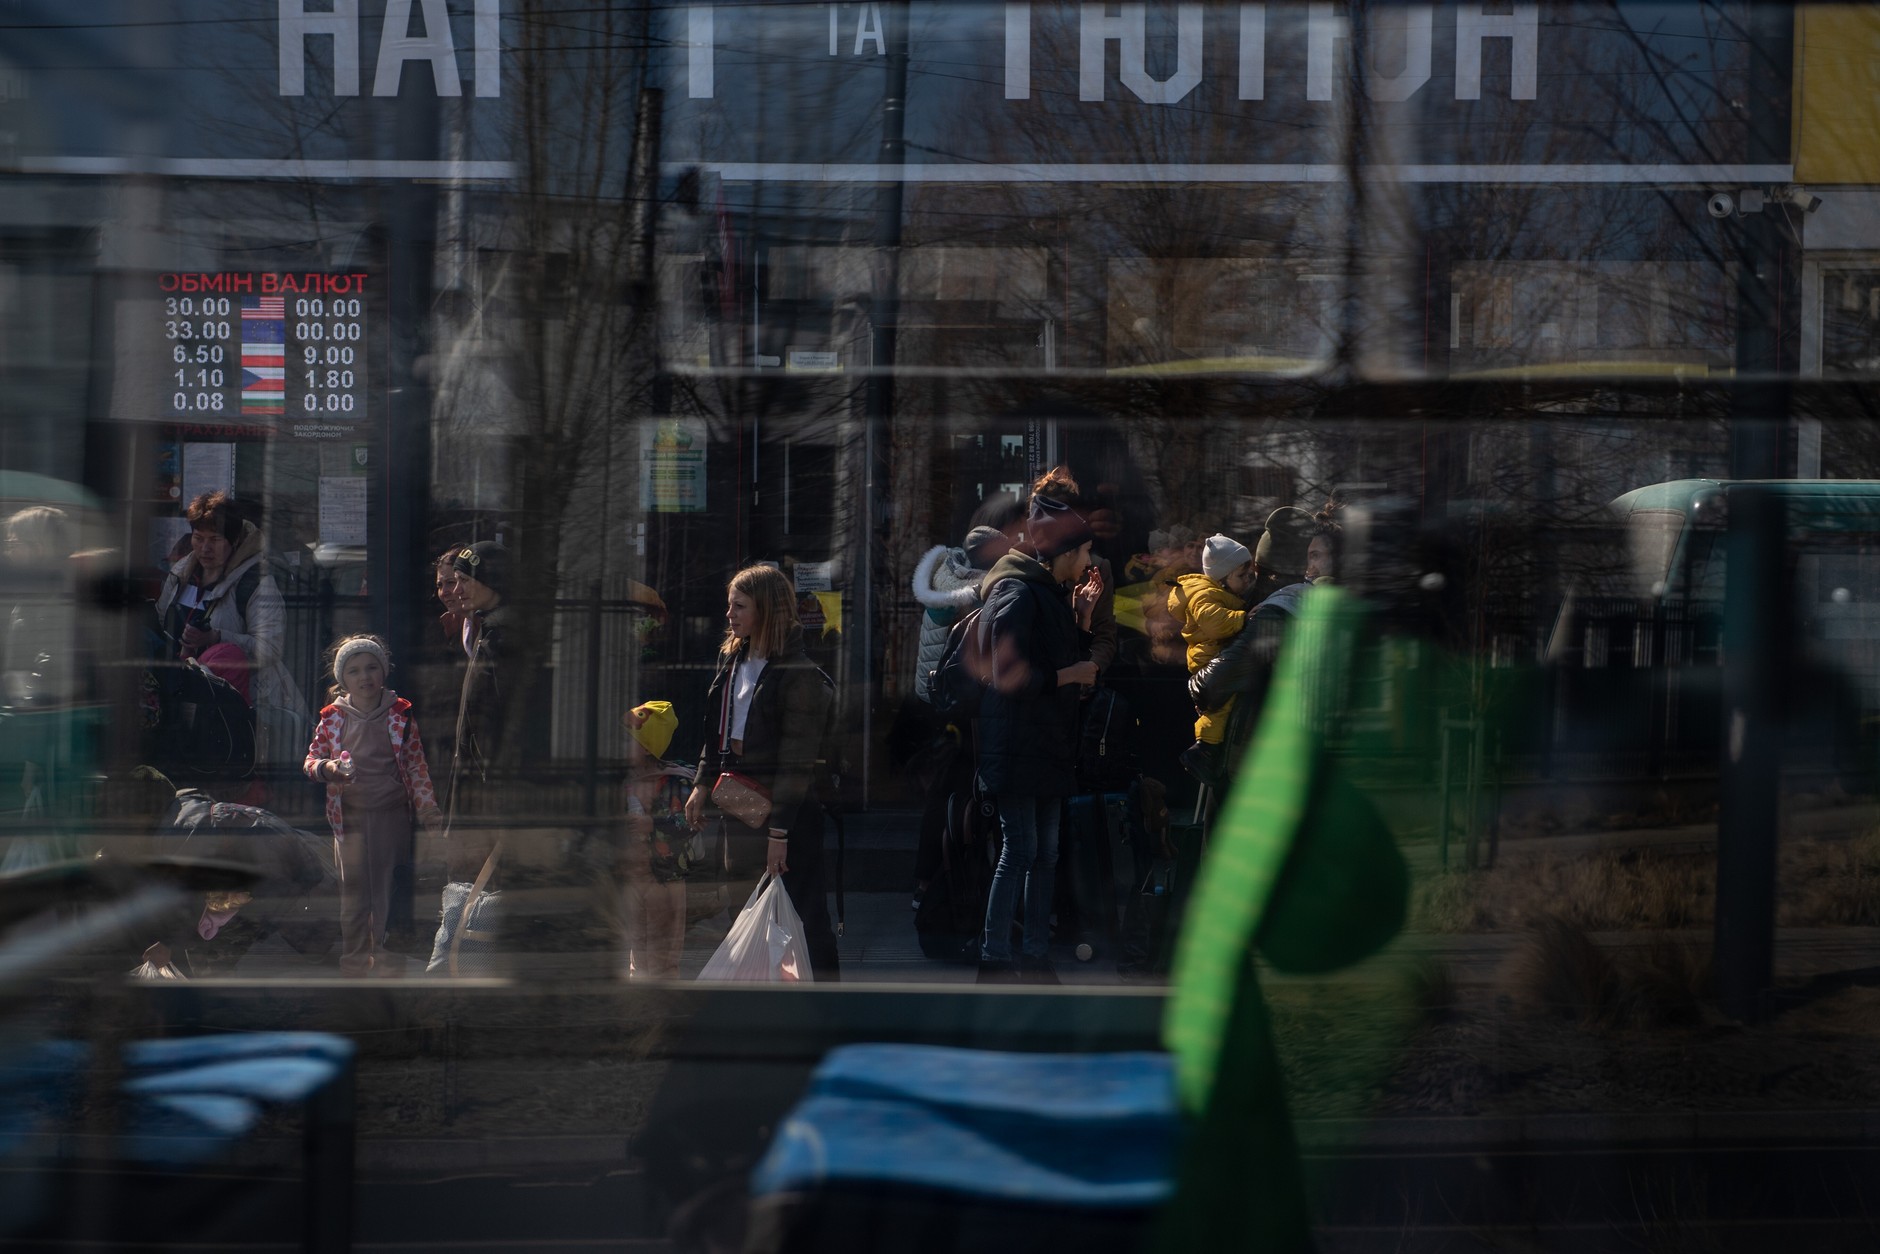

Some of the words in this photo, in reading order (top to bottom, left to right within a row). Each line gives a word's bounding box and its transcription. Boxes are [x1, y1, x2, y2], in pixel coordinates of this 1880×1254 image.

[158, 272, 253, 292] ОБМІН
[261, 273, 368, 294] ВАЛЮТ
[165, 297, 231, 316] 30.00
[295, 298, 361, 317] 00.00
[165, 321, 231, 340] 33.00
[295, 322, 361, 341] 00.00
[173, 345, 224, 364] 6.50
[303, 346, 354, 365] 9.00
[174, 369, 224, 387] 1.10
[304, 370, 354, 388] 1.80
[173, 392, 224, 411] 0.08
[303, 393, 354, 412] 0.00
[293, 424, 355, 432] ПОДОРОЖУЮЧИХ
